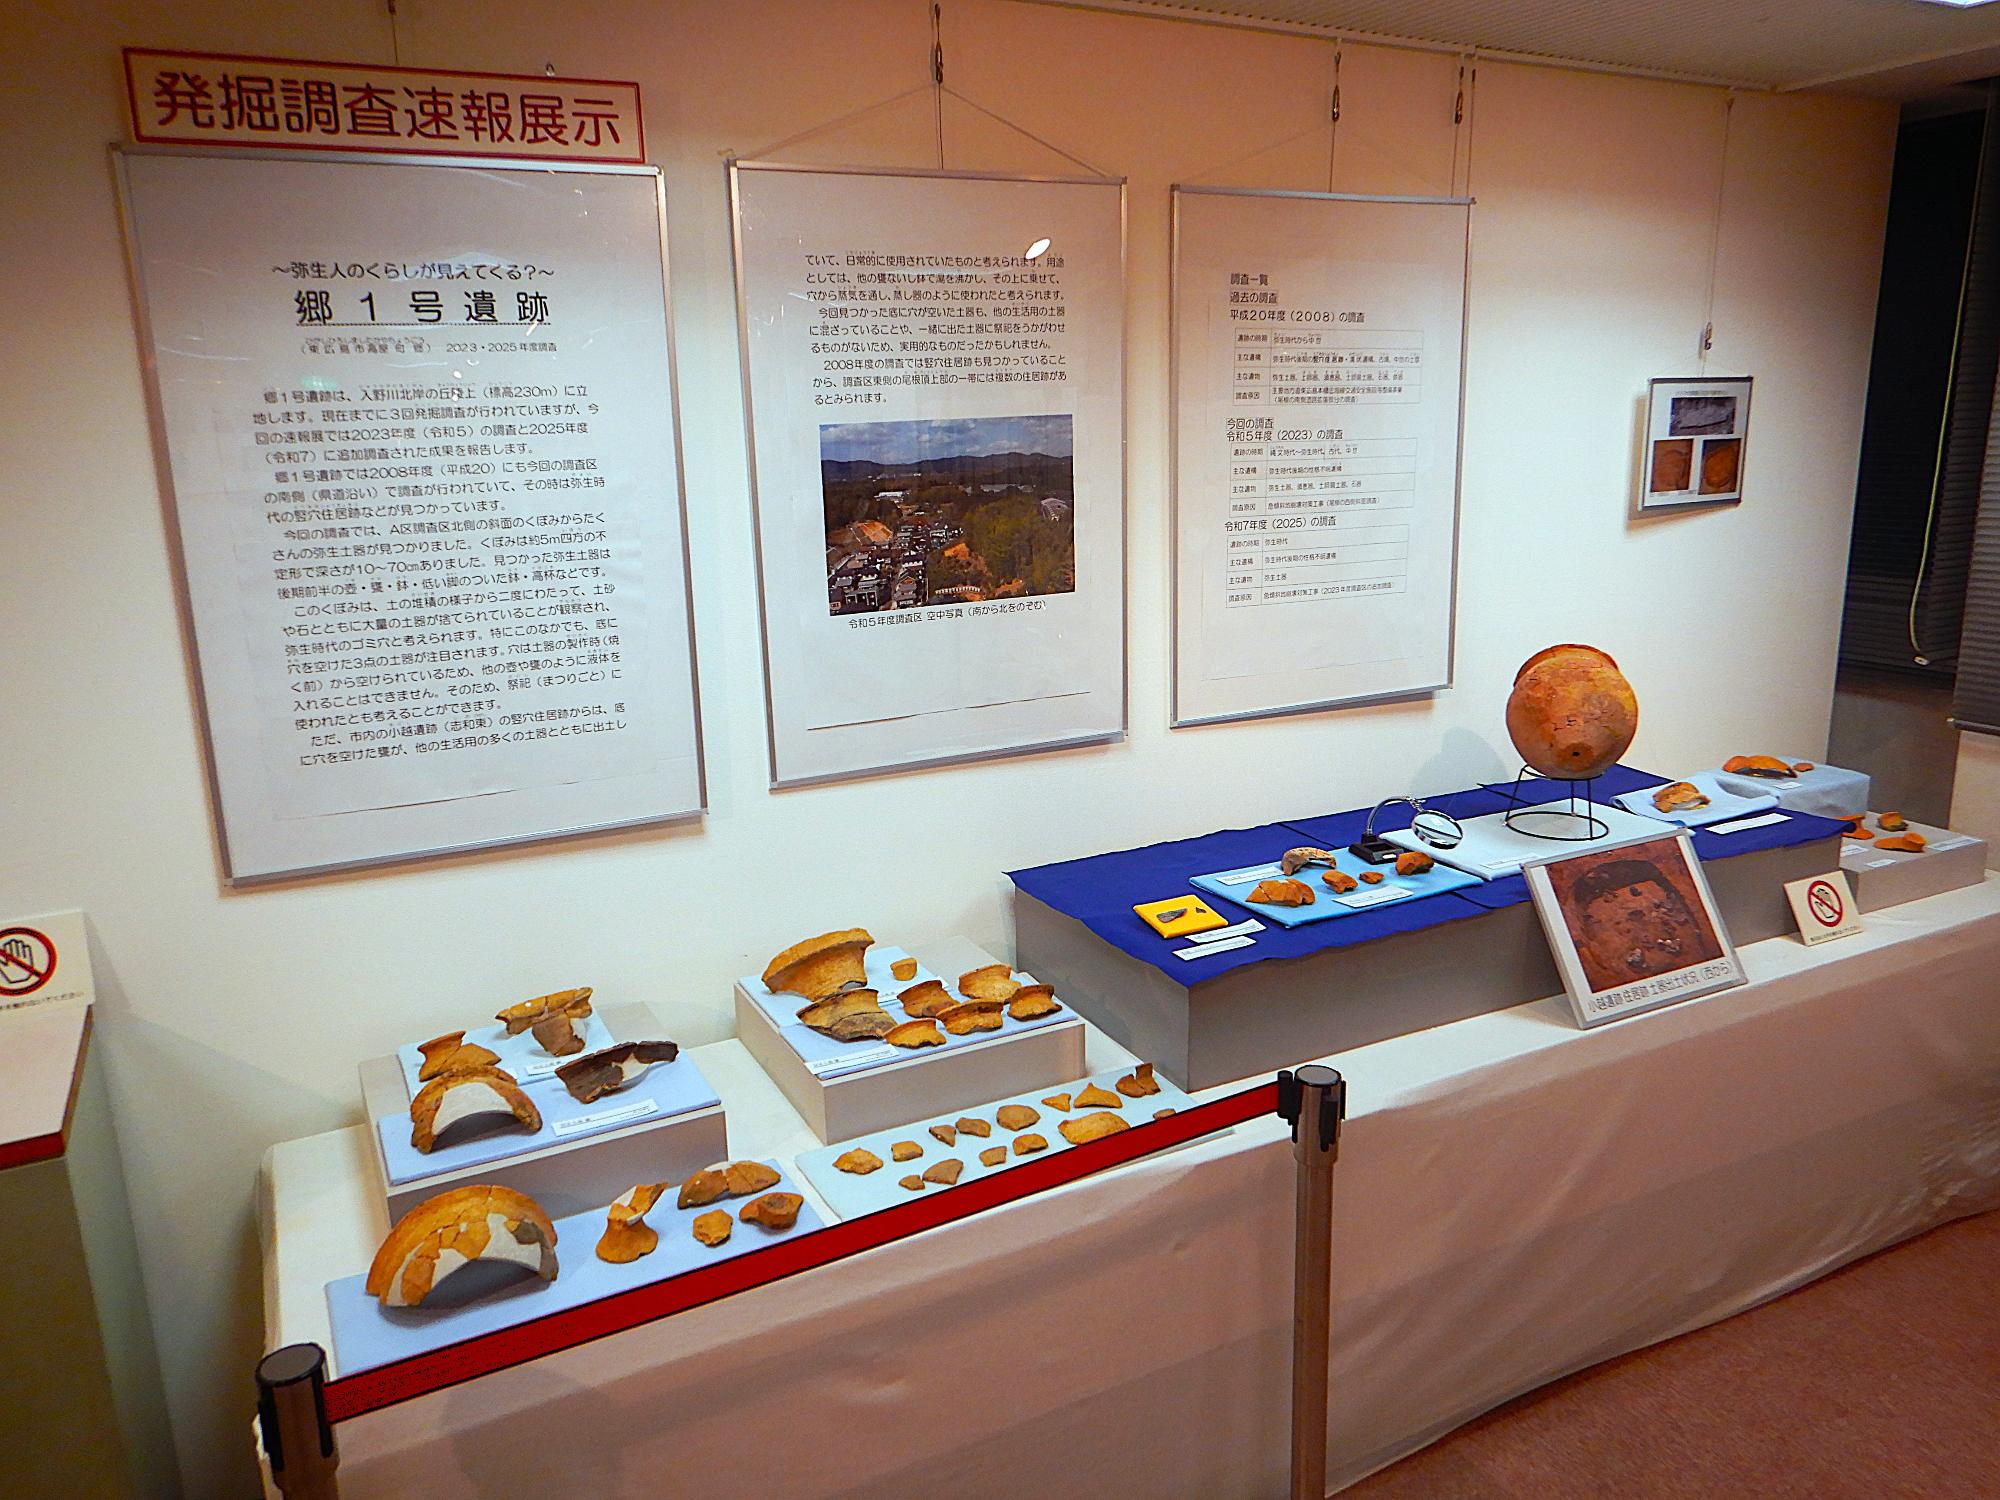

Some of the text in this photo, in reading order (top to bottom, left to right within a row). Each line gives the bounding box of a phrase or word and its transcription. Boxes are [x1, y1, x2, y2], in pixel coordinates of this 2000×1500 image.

[153, 70, 622, 147] 発掘調査速報展示
[1230, 291, 1278, 304] 過去の調査
[1226, 418, 1274, 430] 今回の調査
